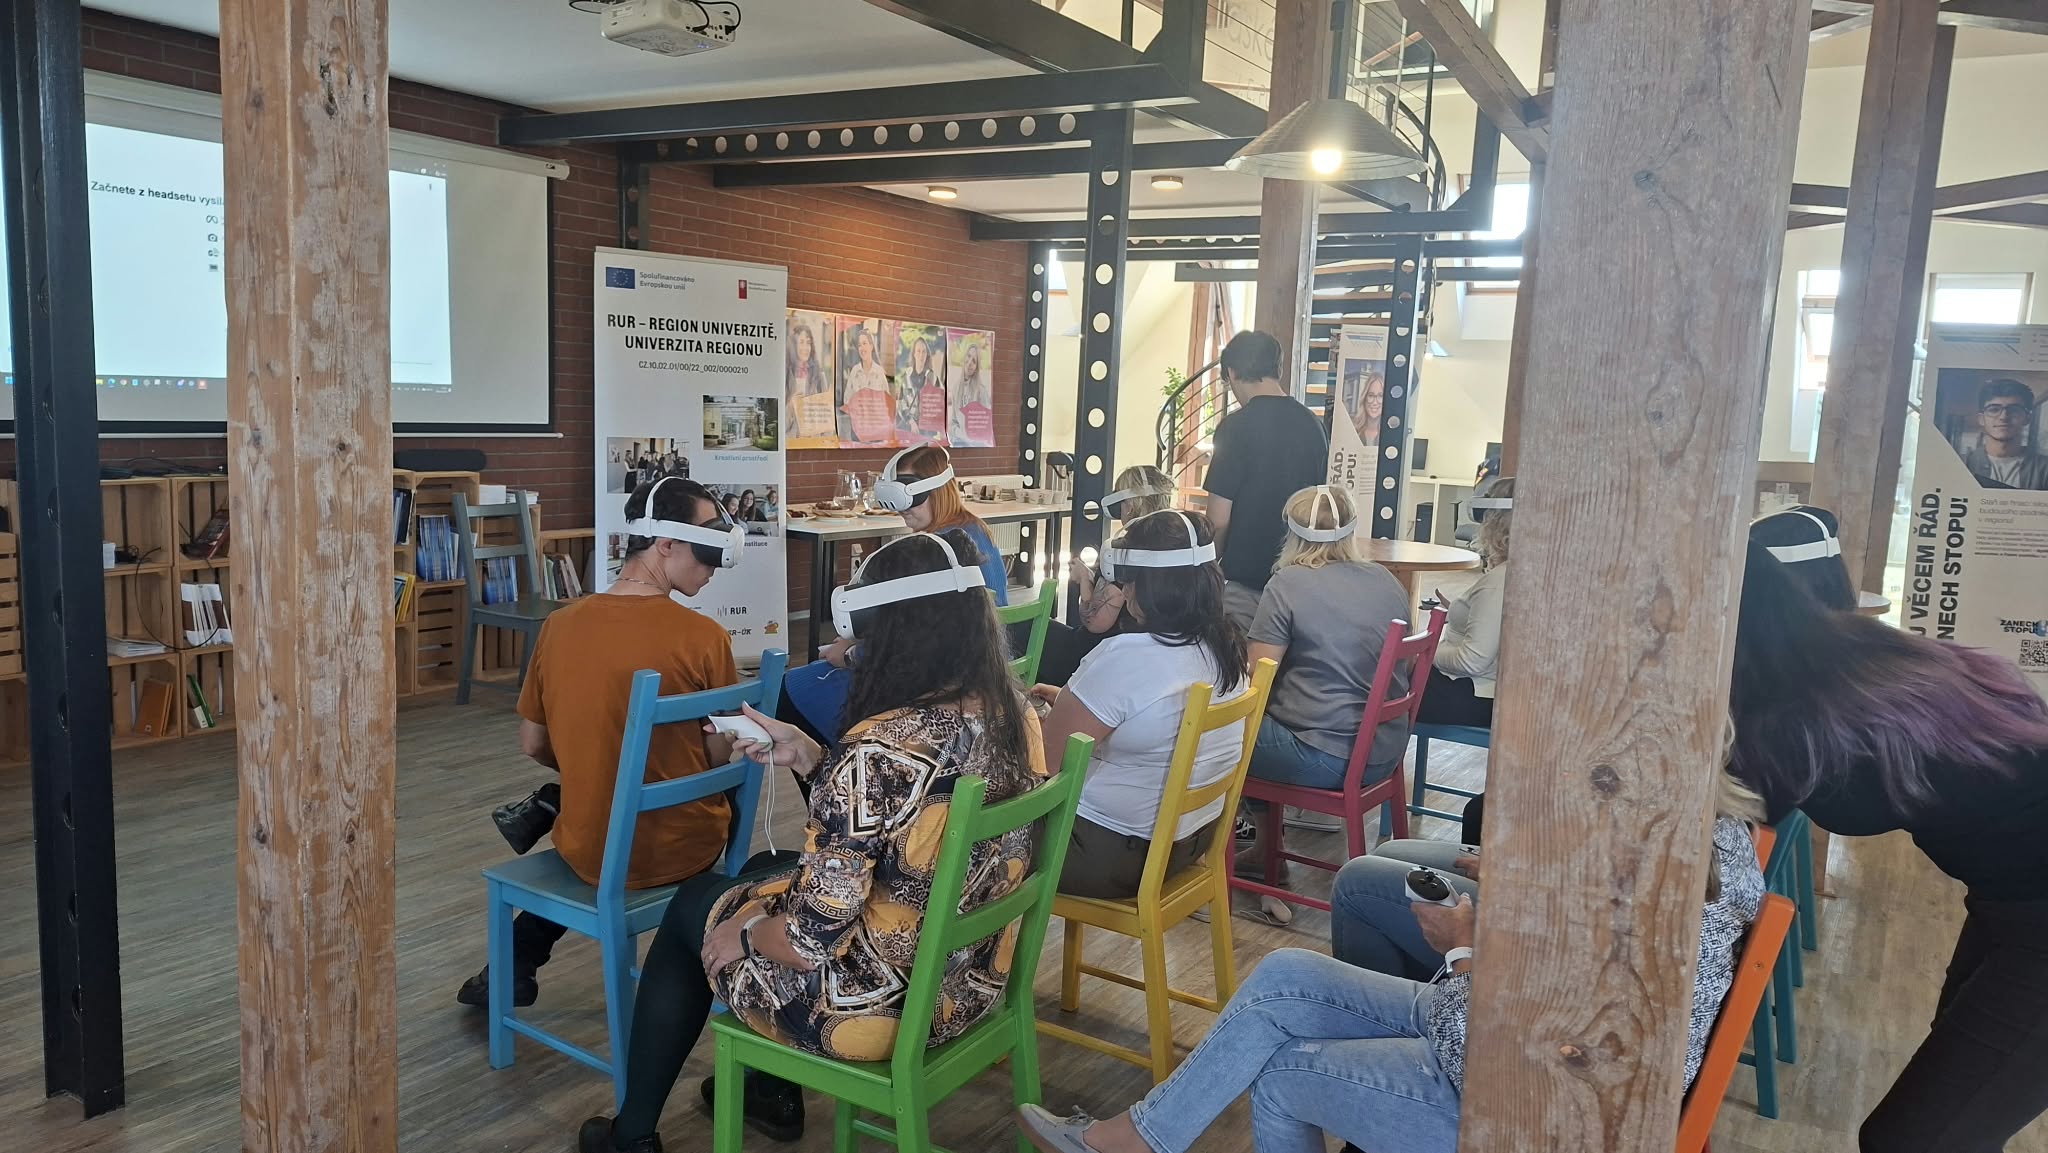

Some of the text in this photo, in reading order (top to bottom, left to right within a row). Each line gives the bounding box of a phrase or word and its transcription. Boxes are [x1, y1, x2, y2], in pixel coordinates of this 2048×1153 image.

[148, 188, 196, 202] headsetu
[639, 272, 695, 283] Spolufinancováno
[640, 280, 673, 290] Evropskou
[607, 314, 636, 329] RUR
[649, 317, 699, 333] REGION
[702, 321, 777, 340] UNIVERZITĚ,
[625, 335, 763, 356] UNIVERZITA REGIONU
[1913, 488, 1941, 538] ŘÁD.
[1943, 498, 1968, 575] STOPU!
[1906, 545, 1935, 619] VĚCEM
[730, 606, 747, 615] RUR
[2000, 619, 2039, 628] ZANECH
